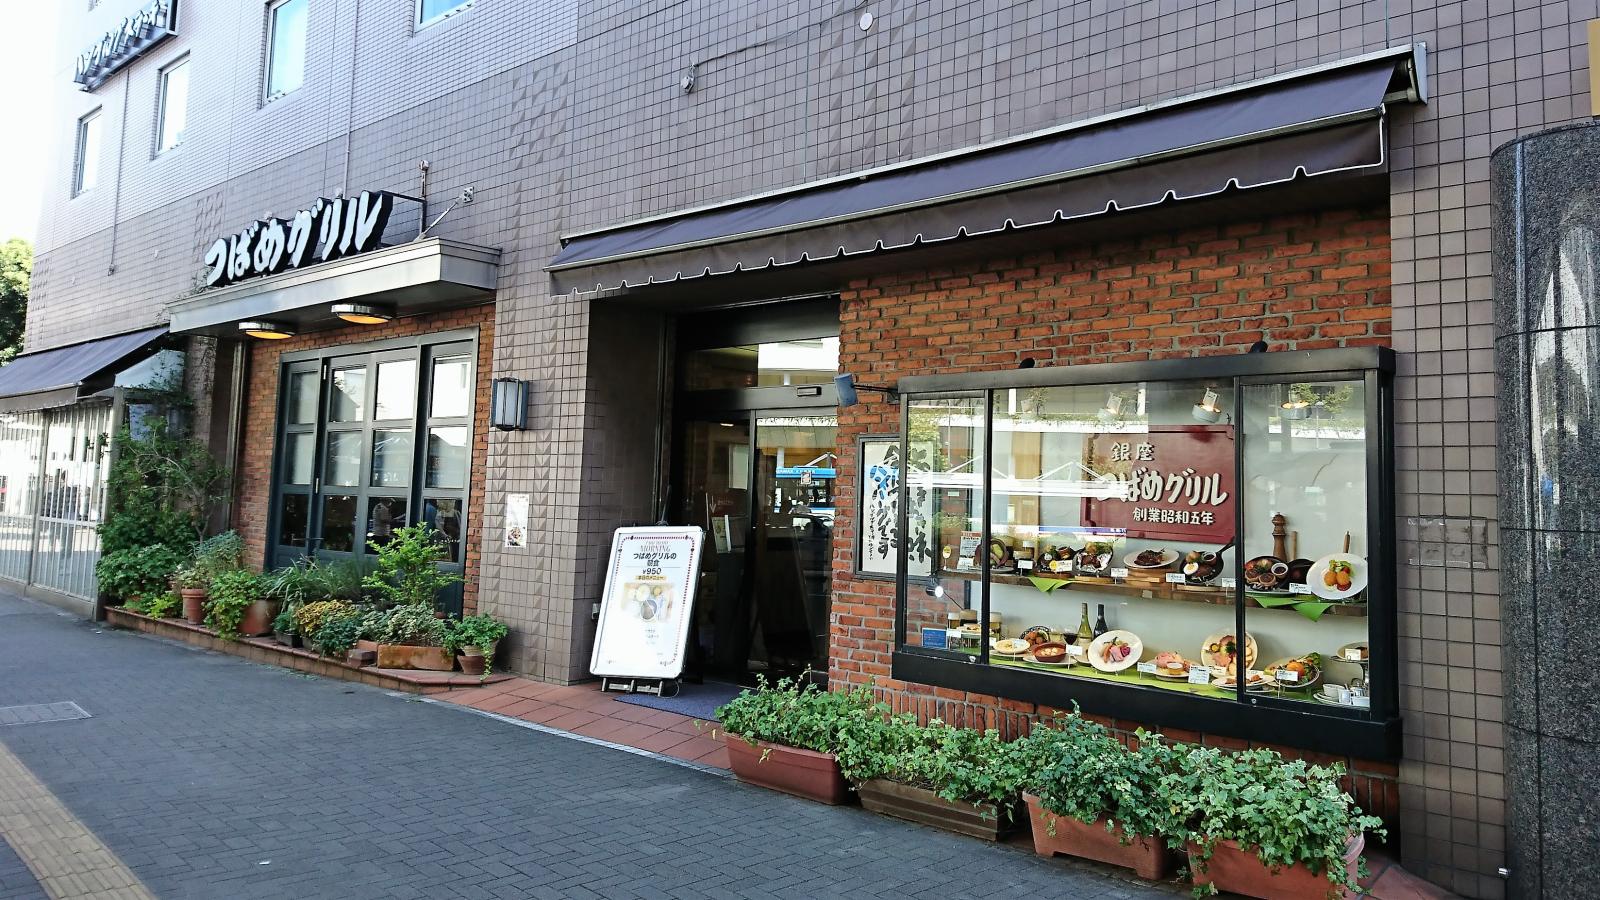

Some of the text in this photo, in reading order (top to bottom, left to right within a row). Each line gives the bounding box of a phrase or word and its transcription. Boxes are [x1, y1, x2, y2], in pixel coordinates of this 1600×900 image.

[205, 190, 382, 286] つばめグリル
[1111, 442, 1155, 461] 銀座
[1097, 467, 1227, 506] つばめグリル
[1132, 507, 1214, 526] 創業昭和五年
[633, 552, 677, 560] つばめグリルの
